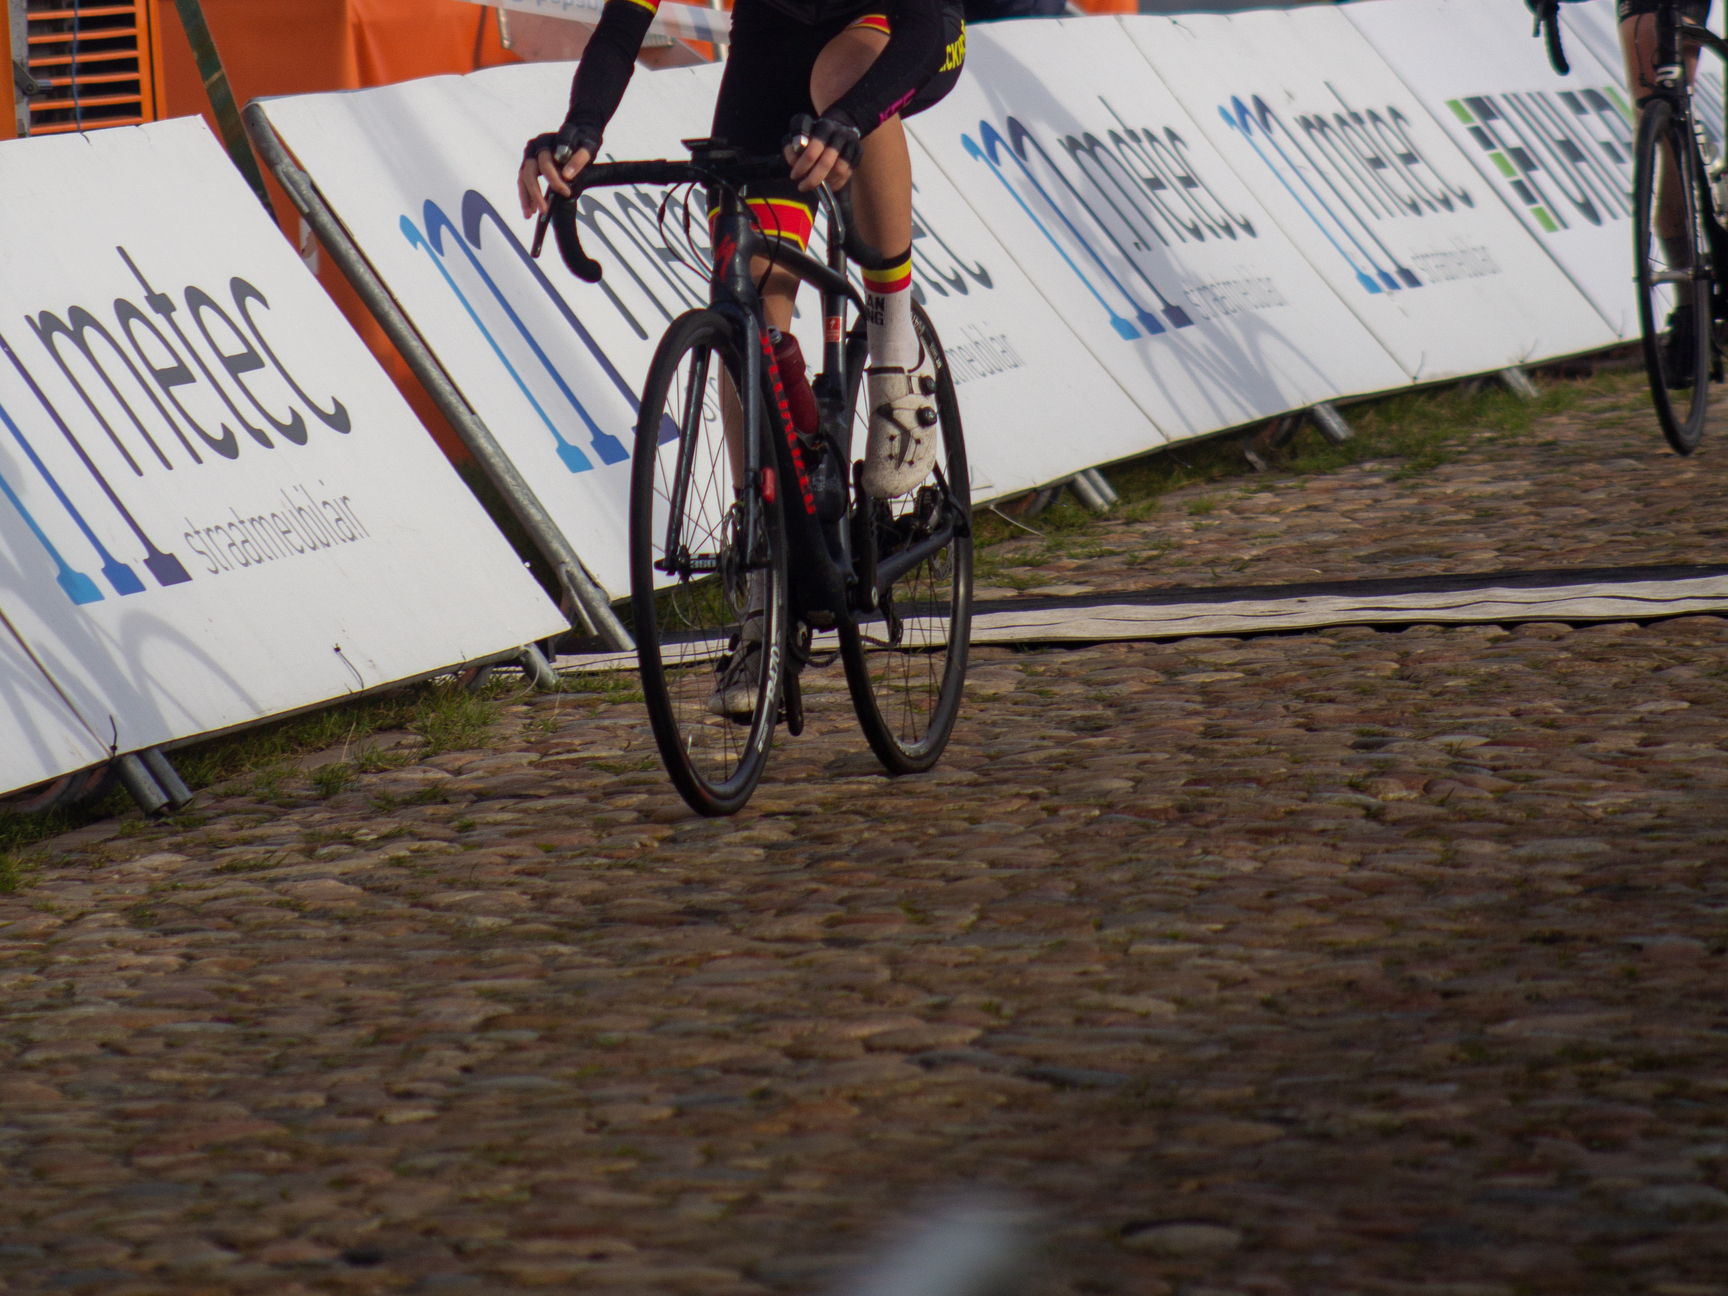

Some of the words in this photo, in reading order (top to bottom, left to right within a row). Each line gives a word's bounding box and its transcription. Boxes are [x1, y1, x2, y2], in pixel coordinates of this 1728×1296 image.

[1058, 95, 1258, 253] metec
[1294, 81, 1475, 220] metec
[24, 246, 352, 477] metec
[184, 479, 370, 575] straatmeubilair
